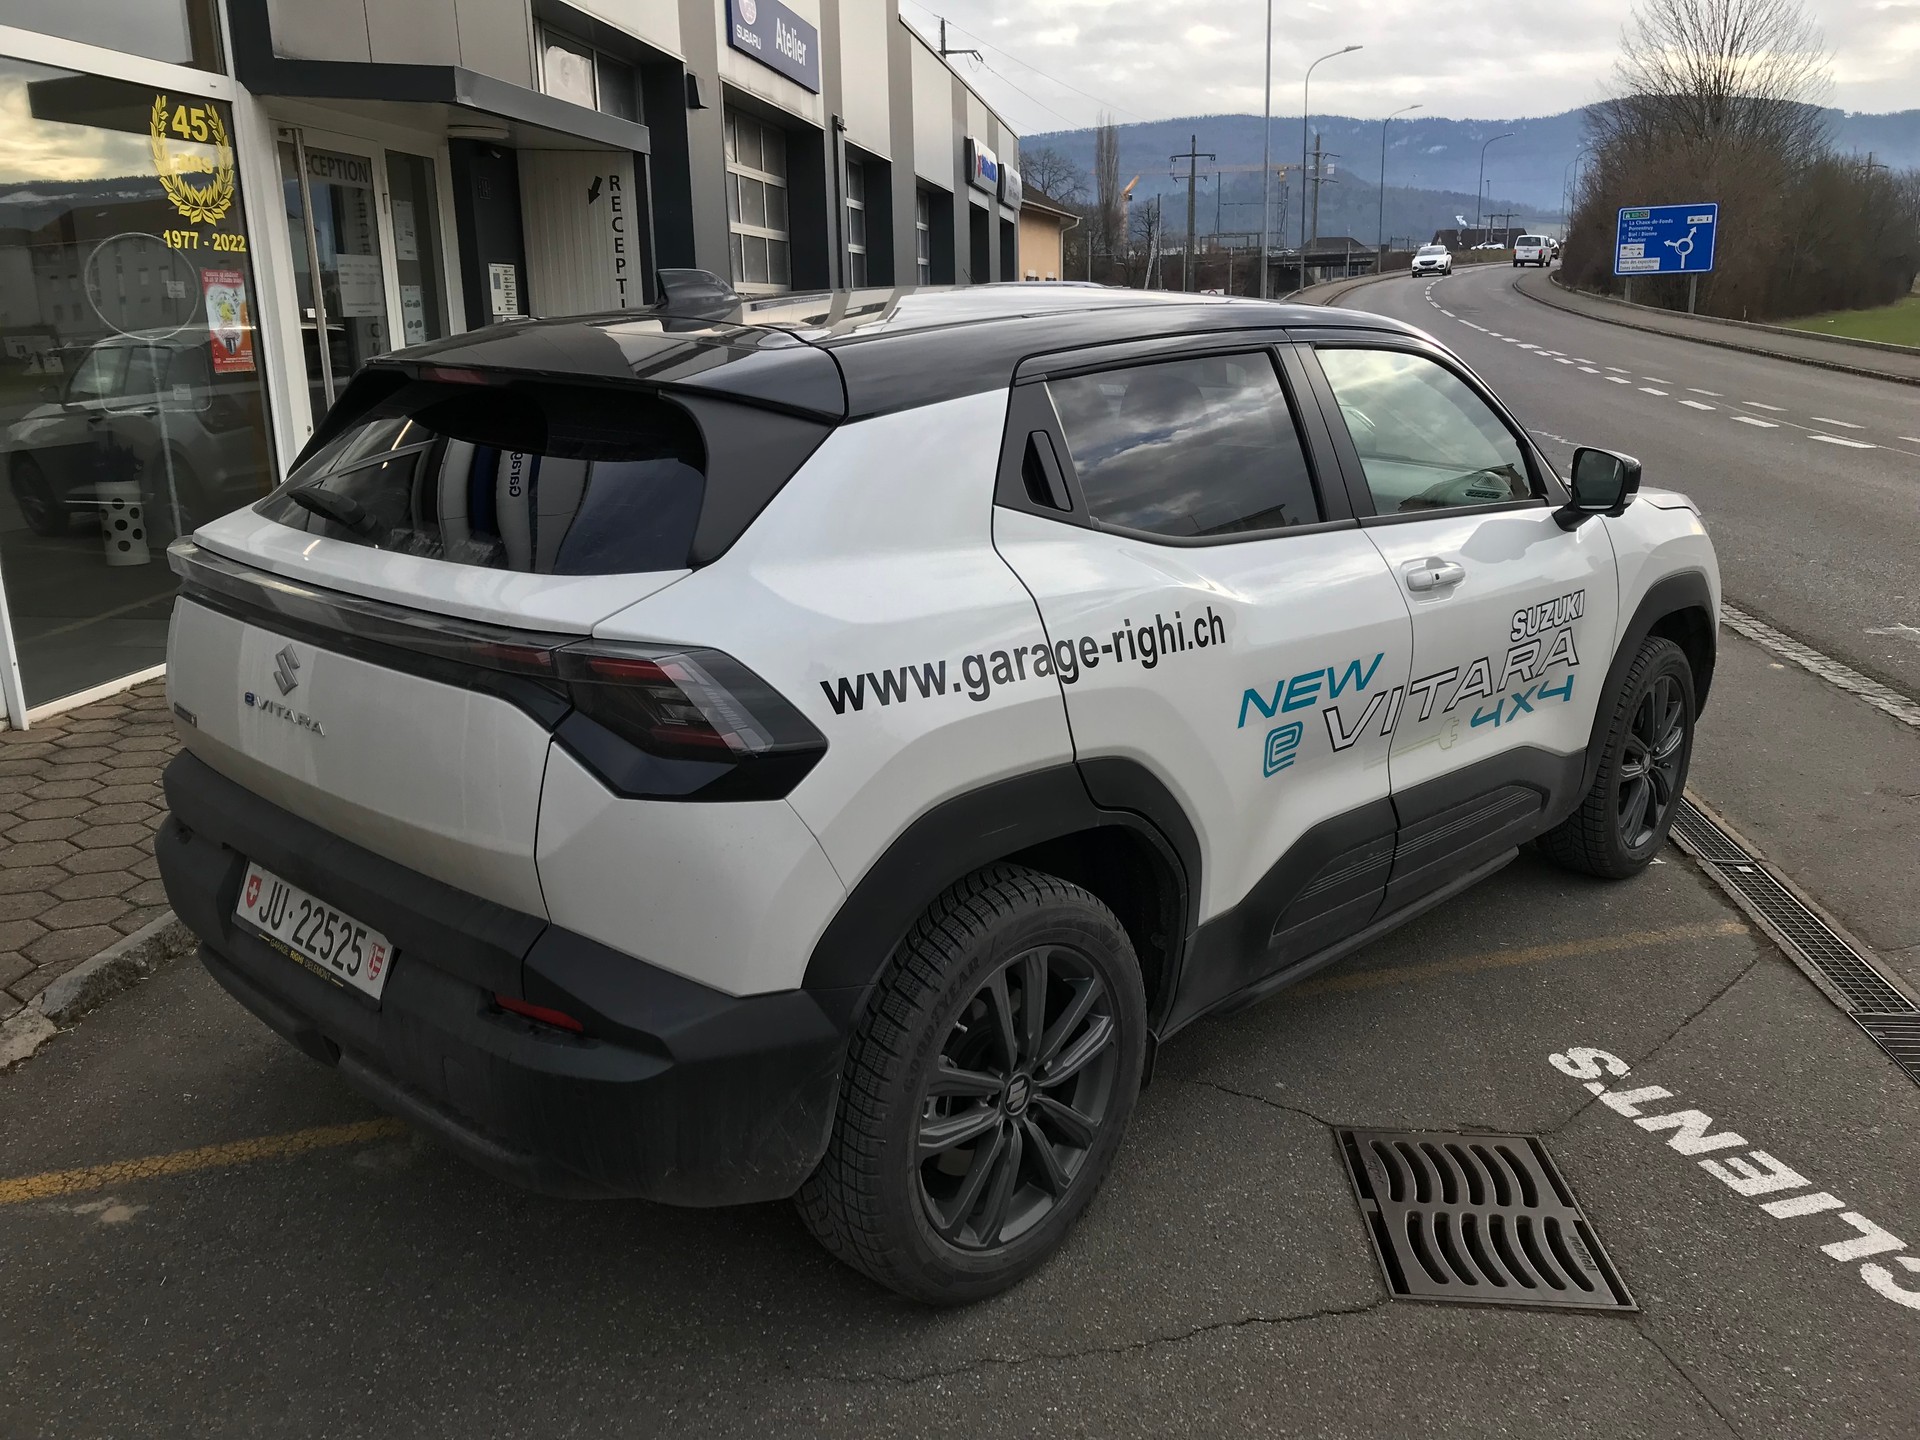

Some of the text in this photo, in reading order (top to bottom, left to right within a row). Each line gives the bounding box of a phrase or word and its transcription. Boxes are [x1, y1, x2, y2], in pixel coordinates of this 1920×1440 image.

[736, 24, 761, 50] SUBARU
[775, 17, 806, 66] Atelier
[171, 104, 208, 142] 45
[177, 153, 213, 174] ans
[163, 229, 199, 250] 1977
[211, 232, 246, 252] 2022
[1510, 589, 1586, 642] SUZUKI
[820, 606, 1226, 715] www.garage-righi.ch
[1237, 652, 1385, 729] NEW
[1322, 627, 1580, 752] VITARA
[269, 938, 290, 956] GARAGE
[289, 950, 304, 965] RIGHI
[1548, 1046, 1920, 1310] CLIENTS
